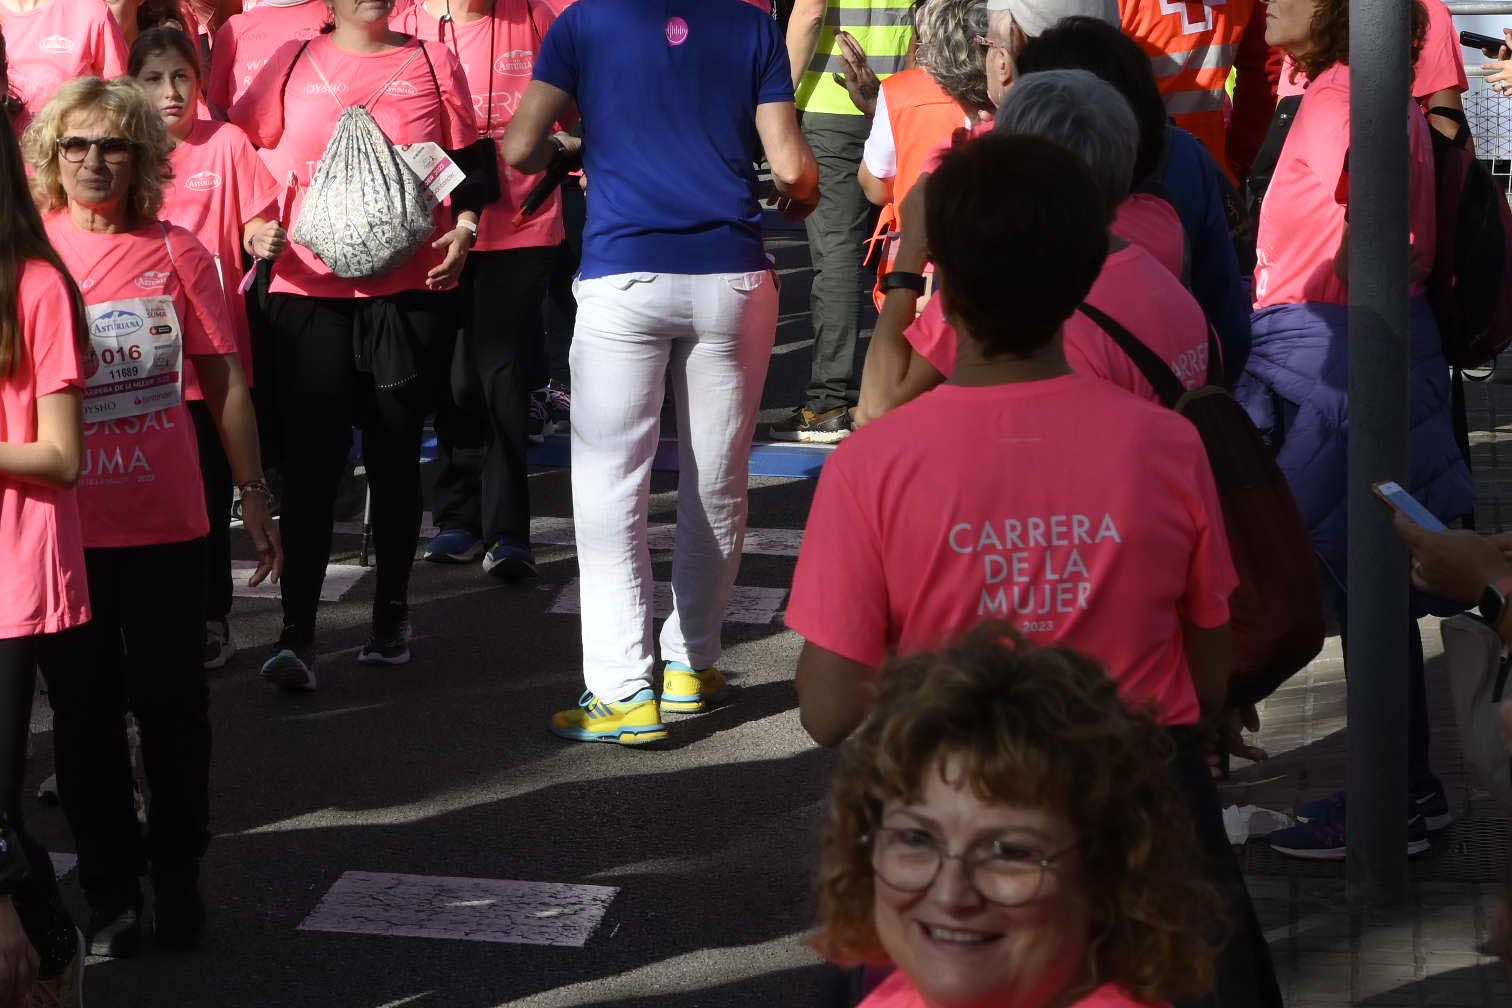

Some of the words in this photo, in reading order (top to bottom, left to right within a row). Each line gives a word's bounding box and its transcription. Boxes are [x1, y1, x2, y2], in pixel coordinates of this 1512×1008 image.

[146, 311, 167, 319] SUMA
[94, 319, 140, 334] ASTURIANA
[102, 345, 142, 366] 016
[948, 513, 1123, 555] CARRERA
[984, 552, 1030, 584] DE
[1045, 548, 1090, 580] LA
[977, 582, 1092, 616] MUJER
[1023, 620, 1054, 632] 2023
